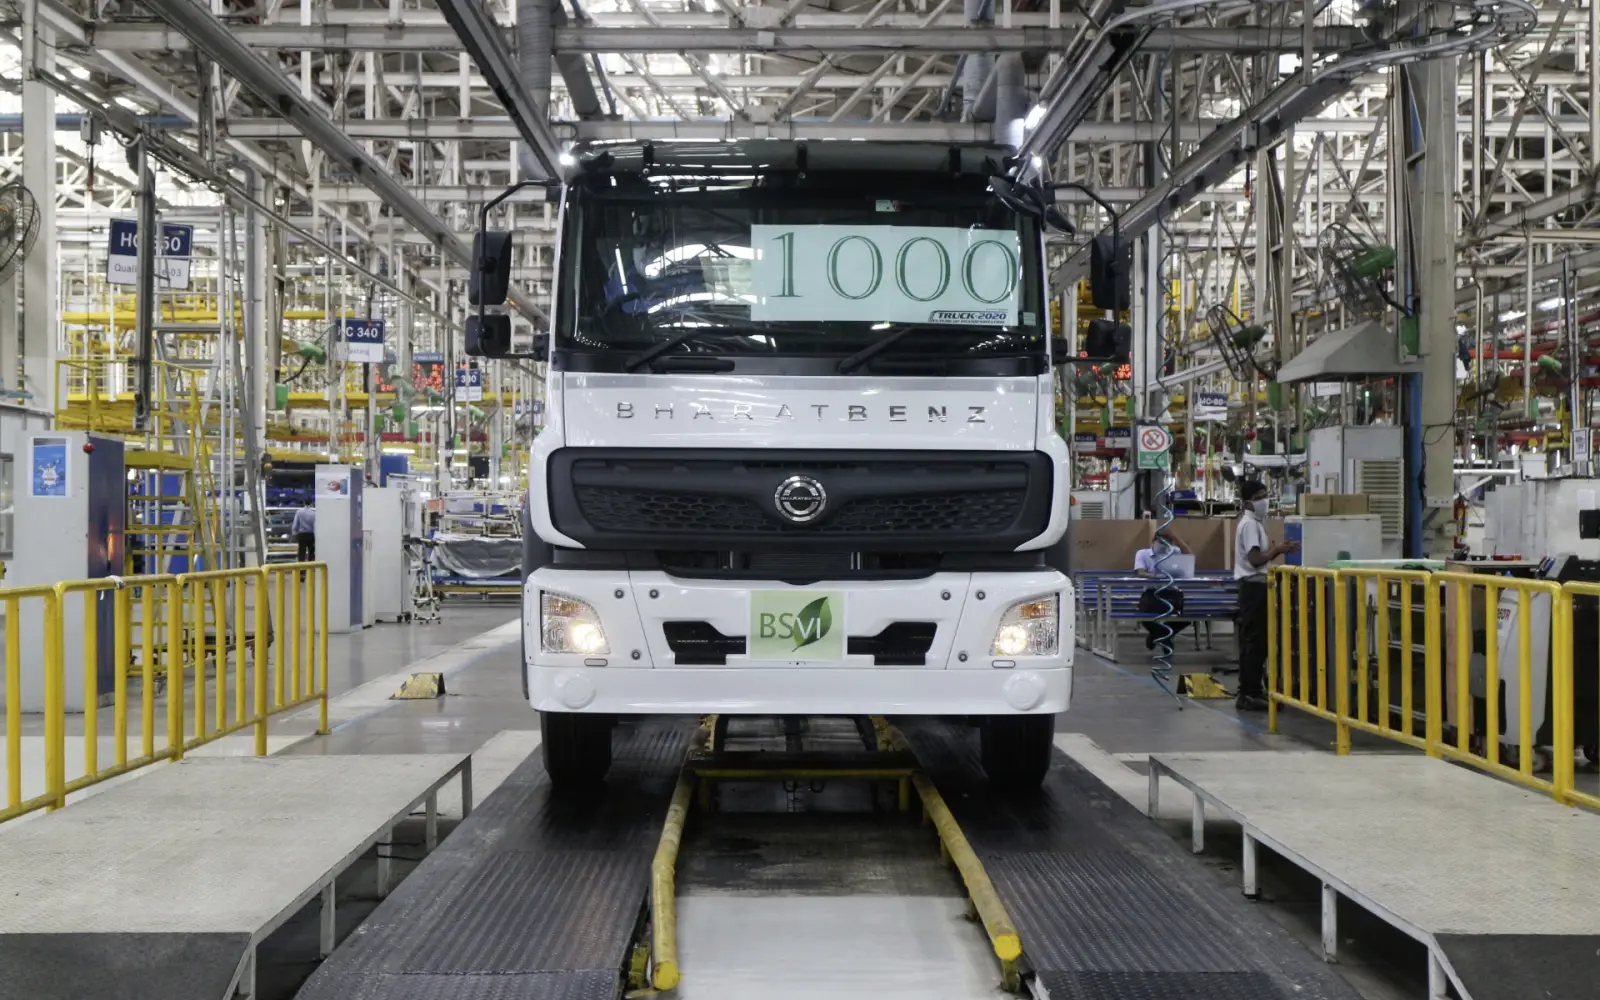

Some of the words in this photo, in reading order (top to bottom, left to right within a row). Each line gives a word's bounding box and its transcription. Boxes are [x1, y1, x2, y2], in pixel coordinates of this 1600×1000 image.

[769, 231, 1018, 304] 1000
[356, 327, 379, 338] 340
[616, 402, 986, 423] BHARATBENZ
